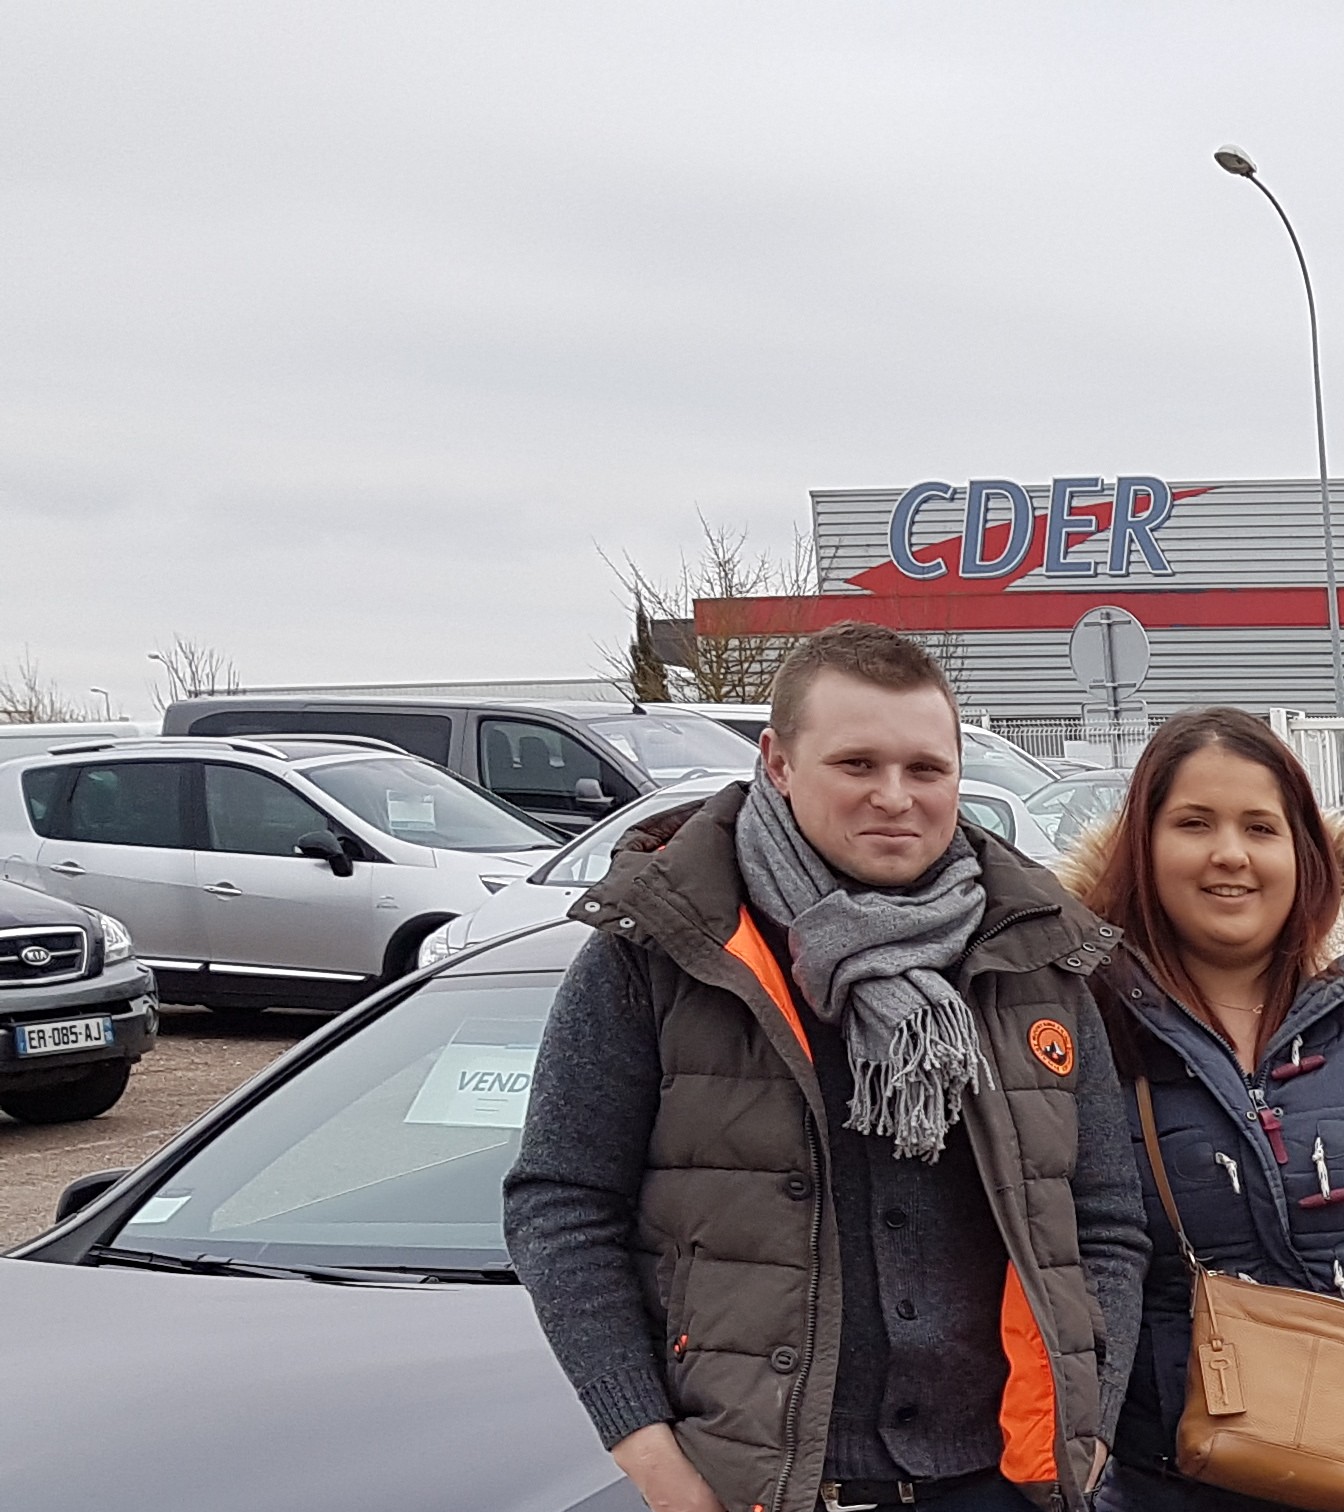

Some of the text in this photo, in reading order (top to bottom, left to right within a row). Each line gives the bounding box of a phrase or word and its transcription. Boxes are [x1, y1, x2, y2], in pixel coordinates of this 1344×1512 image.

[888, 475, 1175, 579] CDER
[26, 951, 47, 961] KIA
[27, 1021, 102, 1049] ER-085-AJ
[458, 1071, 532, 1093] VEND
